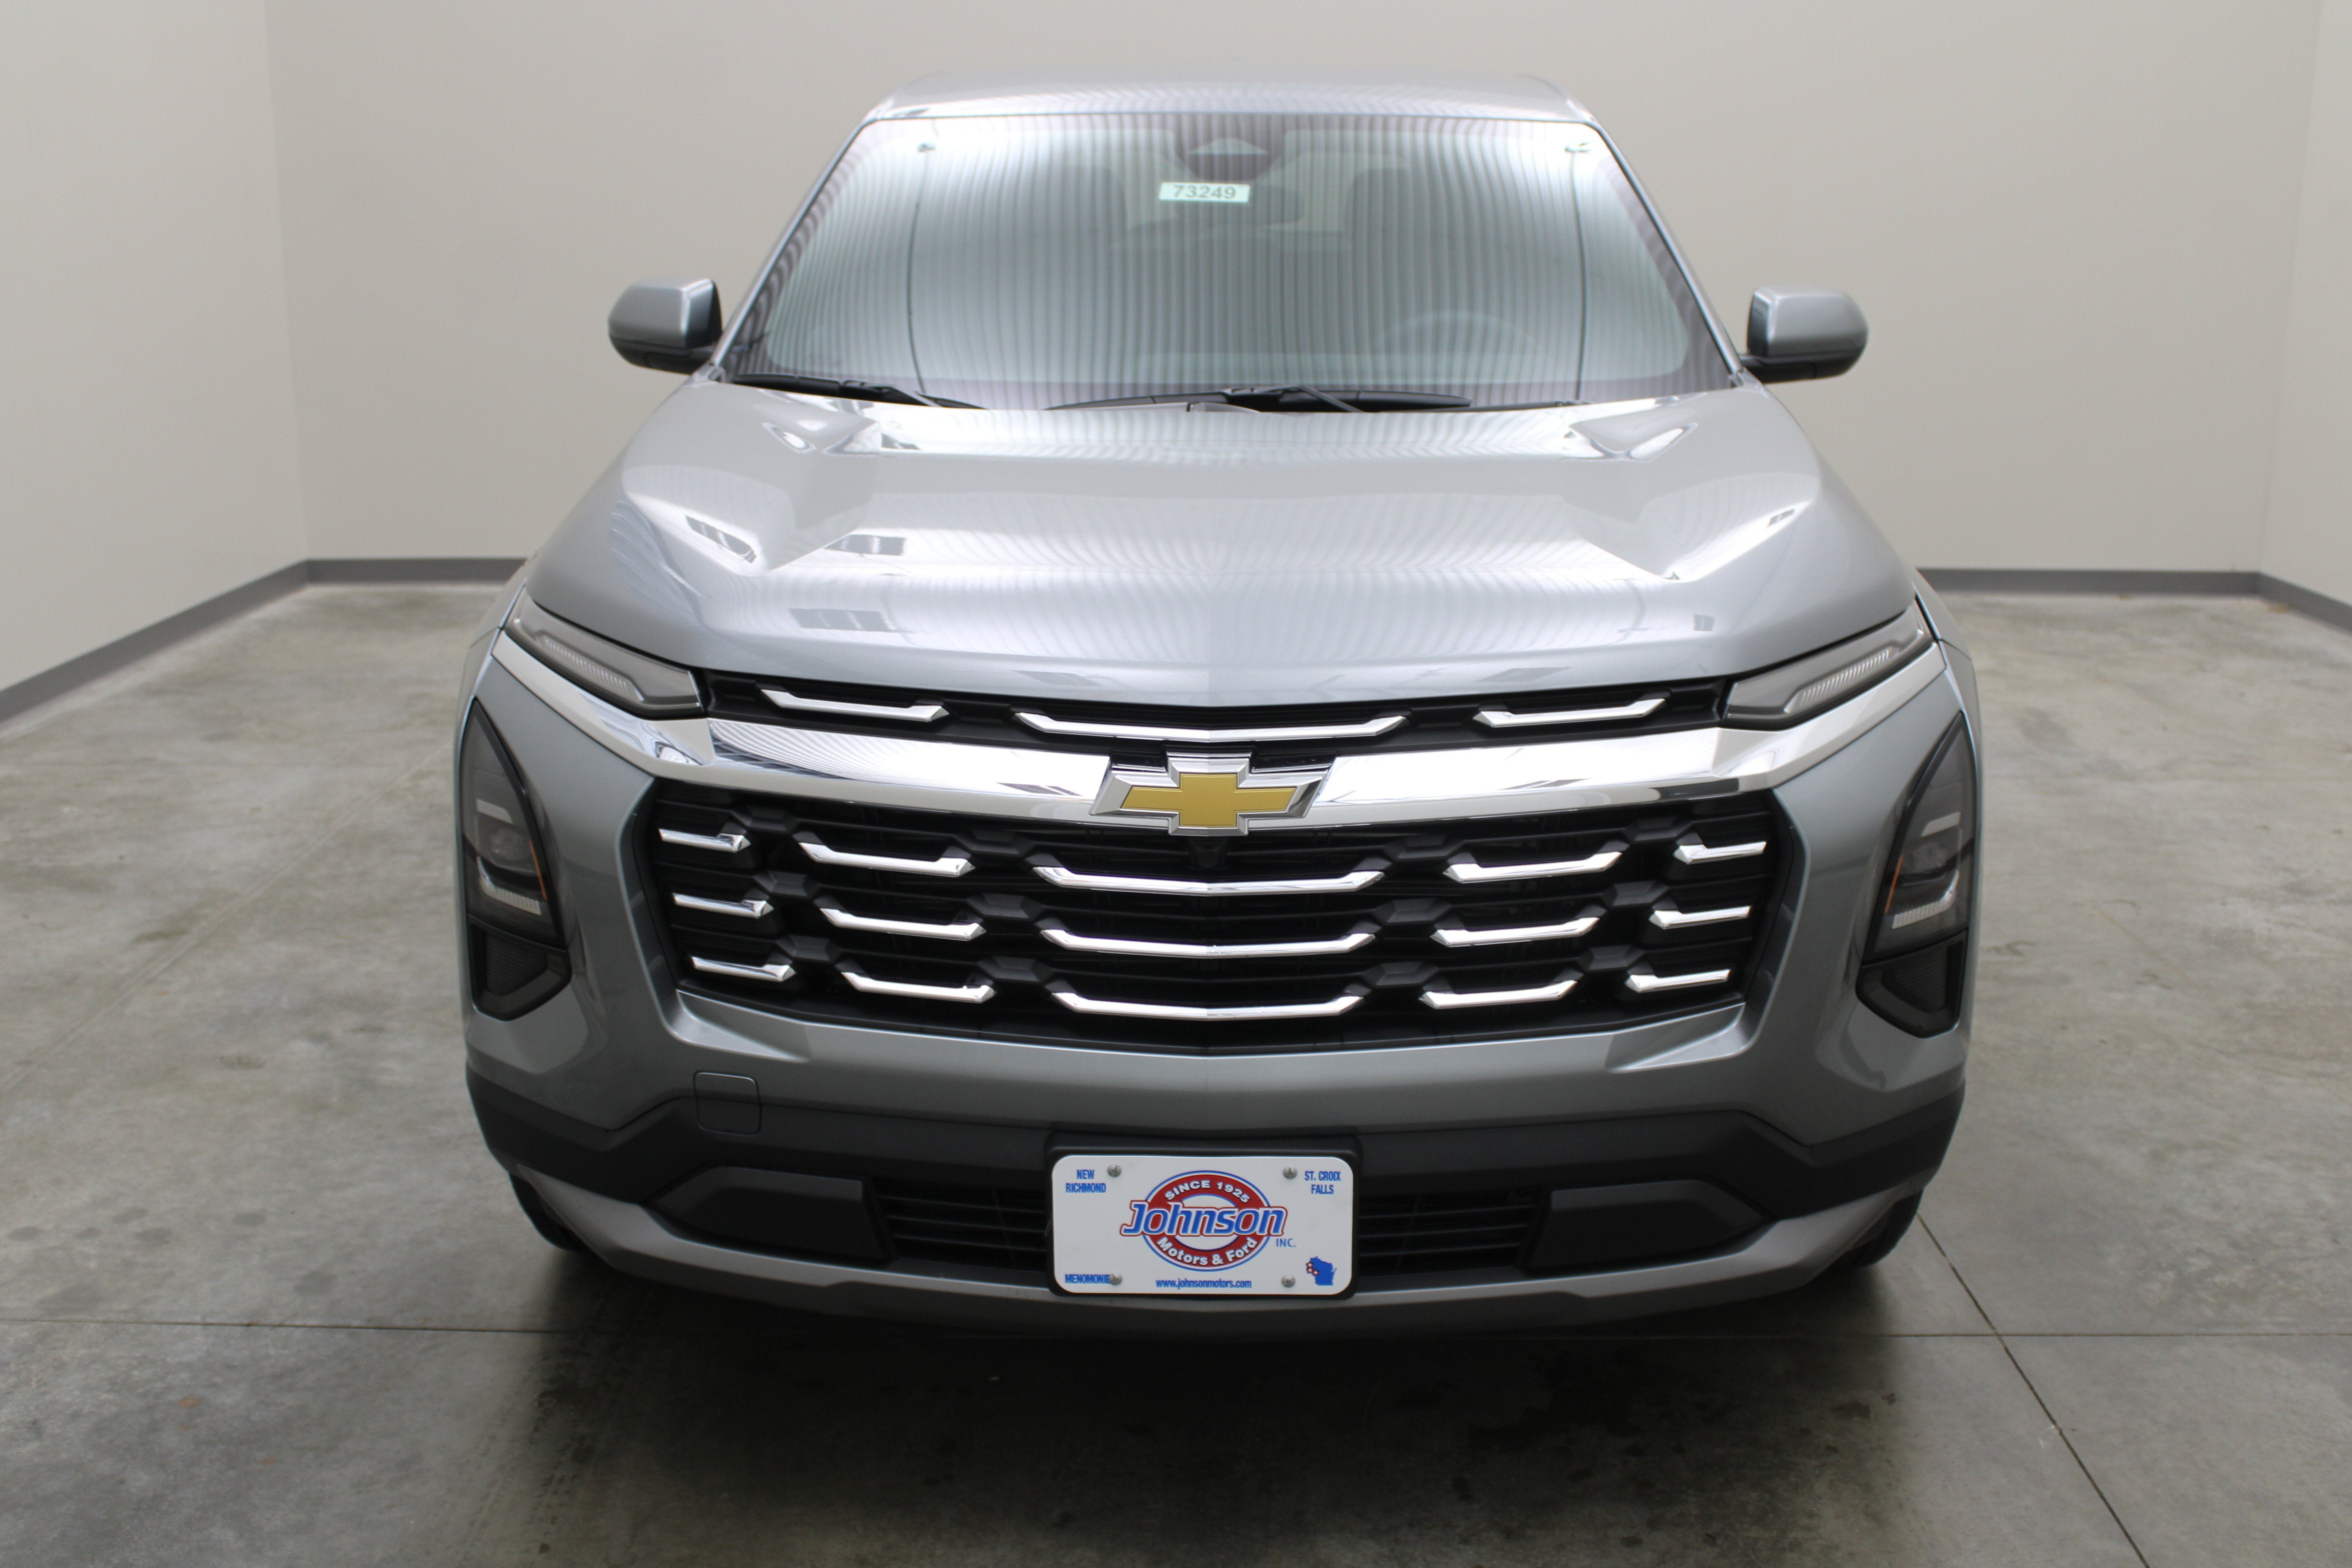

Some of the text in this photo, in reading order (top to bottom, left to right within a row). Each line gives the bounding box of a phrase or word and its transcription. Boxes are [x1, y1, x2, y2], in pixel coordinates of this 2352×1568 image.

[1173, 185, 1236, 199] 73249
[1076, 1169, 1094, 1180] NEW
[1304, 1171, 1341, 1181] ST. CROIX
[1065, 1183, 1106, 1193] RICHMOND
[1164, 1180, 1251, 1203] SINCE 1925
[1311, 1184, 1334, 1194] FALLS
[1120, 1200, 1288, 1236] Johnson
[1276, 1238, 1296, 1247] INC.
[1156, 1236, 1258, 1266] Motors & Ford
[1156, 1278, 1252, 1289] www.johnsonmotors.com
